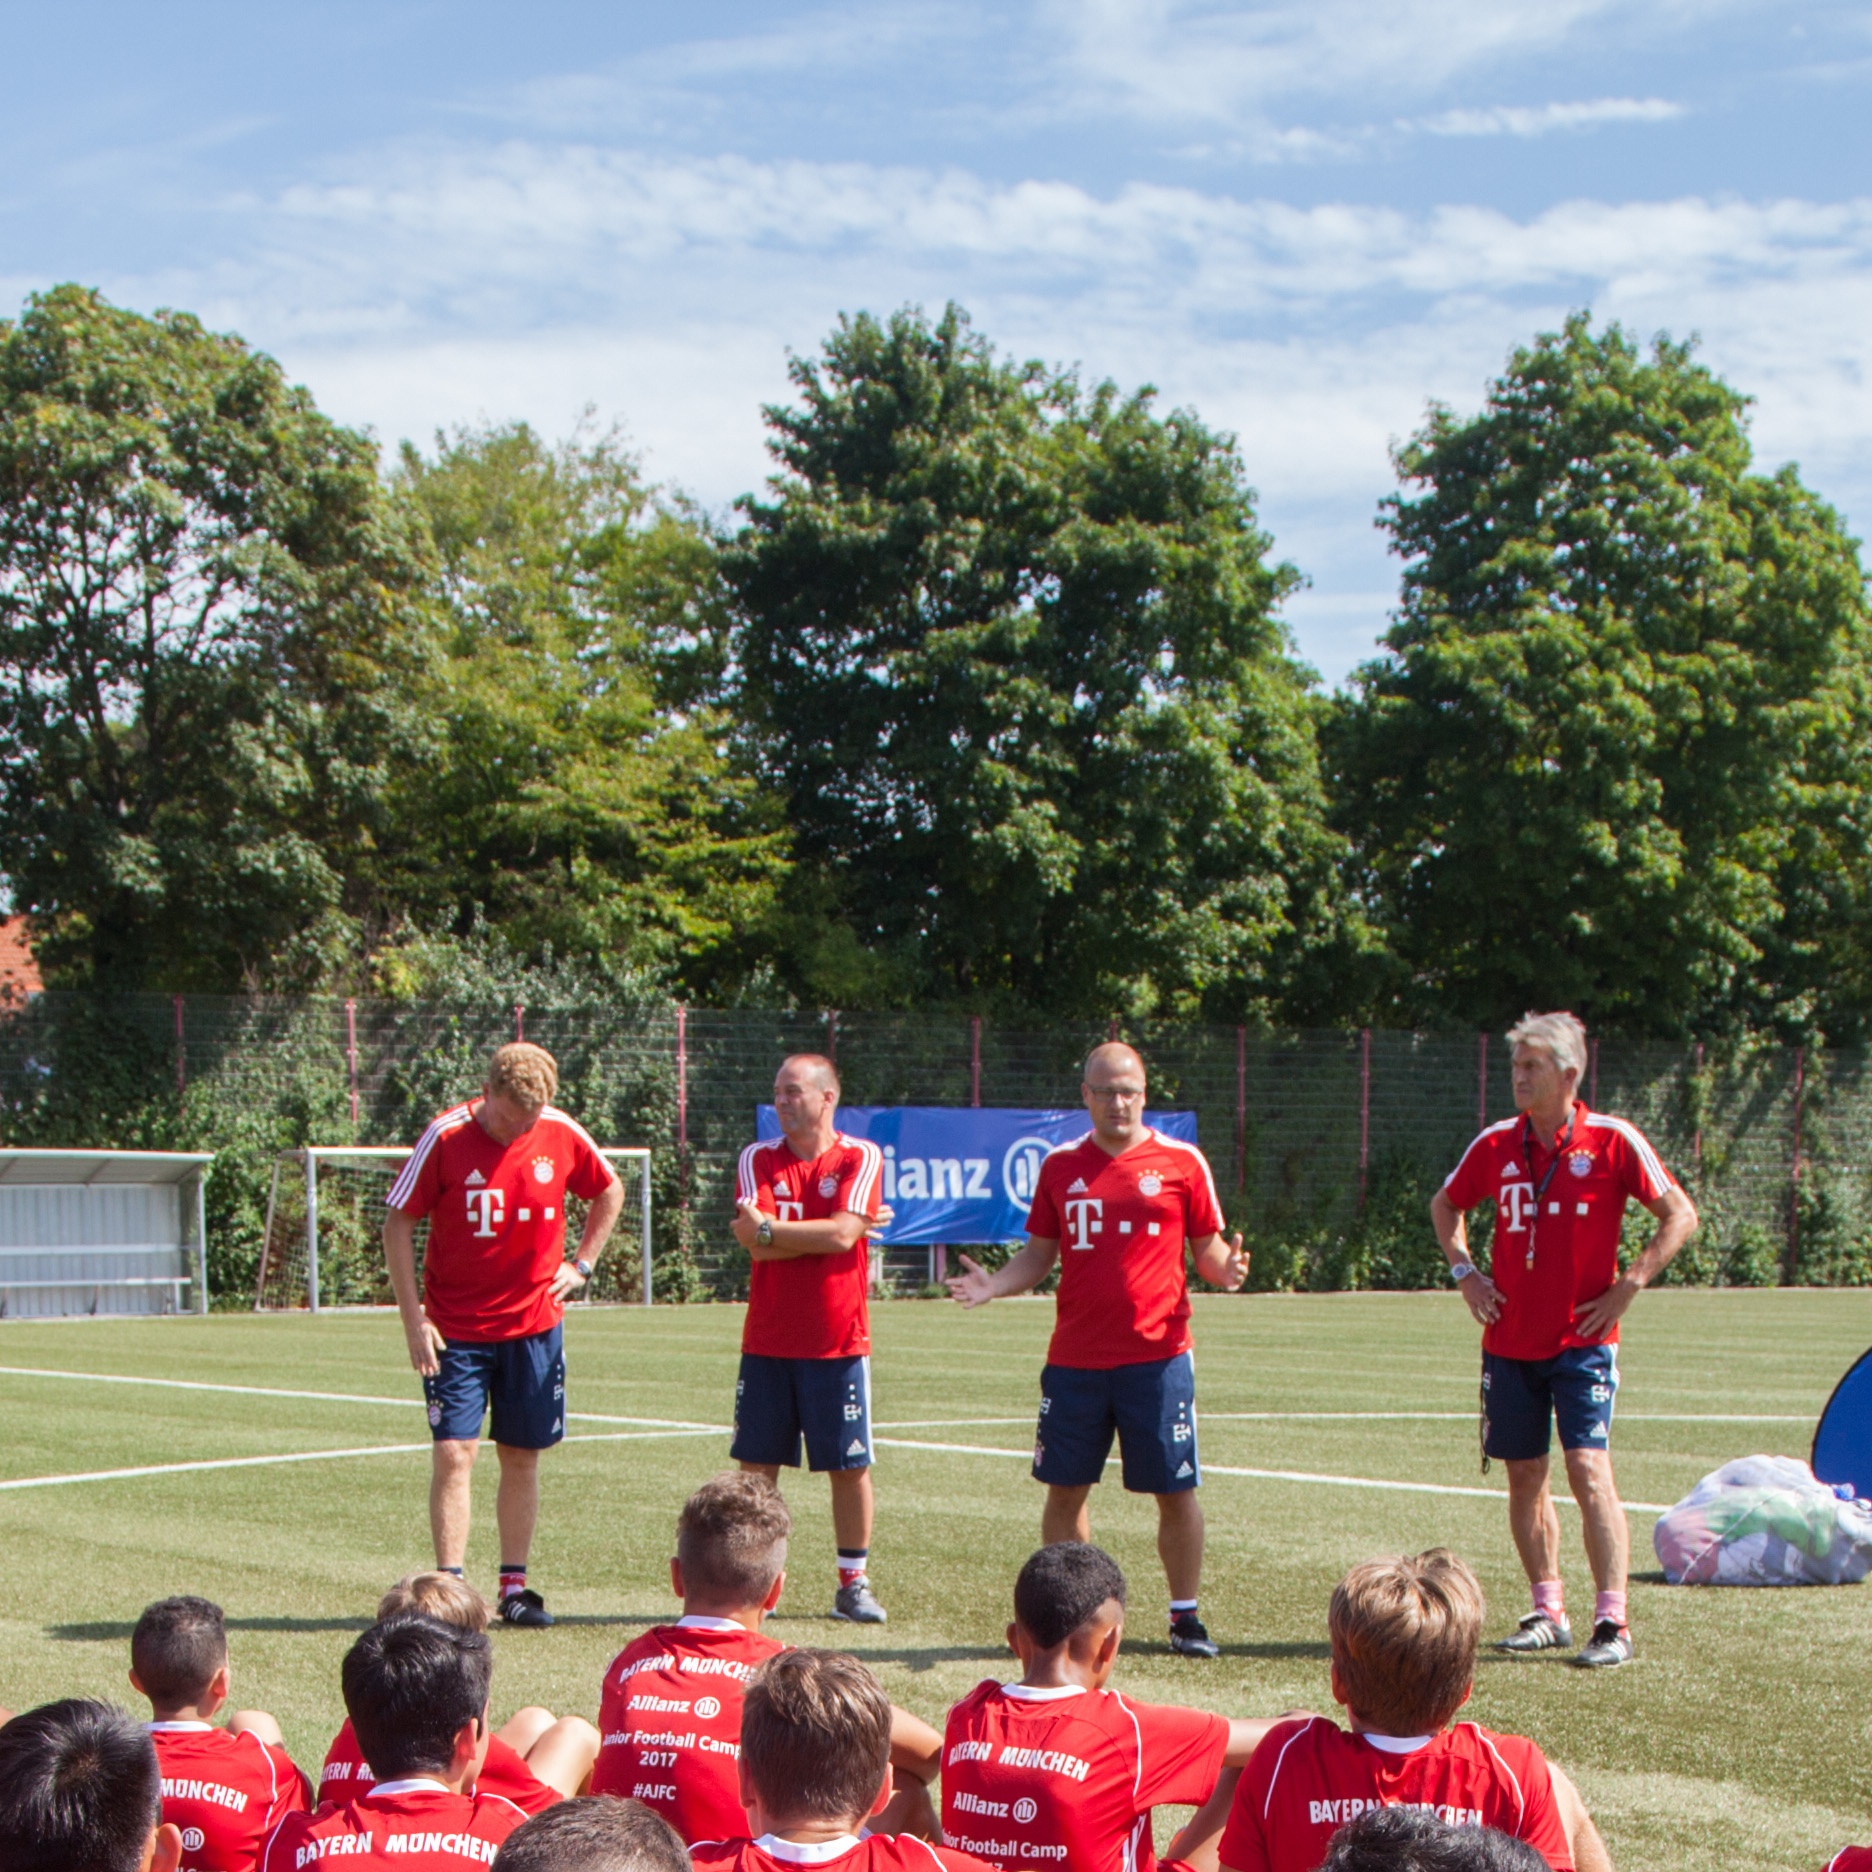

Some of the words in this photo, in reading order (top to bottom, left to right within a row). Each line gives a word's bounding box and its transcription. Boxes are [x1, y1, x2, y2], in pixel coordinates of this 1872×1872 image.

[884, 1145, 992, 1200] ianz
[626, 1694, 692, 1714] Allianz
[632, 1730, 695, 1750] Football
[698, 1733, 742, 1759] Camp
[638, 1750, 679, 1769] 2017
[997, 1745, 1091, 1784] MÜNCHEN
[160, 1777, 248, 1813] MÜNCHEN
[631, 1783, 678, 1802] #AJFC
[952, 1790, 1010, 1819] Allianz
[295, 1831, 373, 1871] BAYERN
[384, 1832, 500, 1865] MÜNCHEN
[959, 1834, 1018, 1858] Football
[1019, 1840, 1069, 1864] Camp
